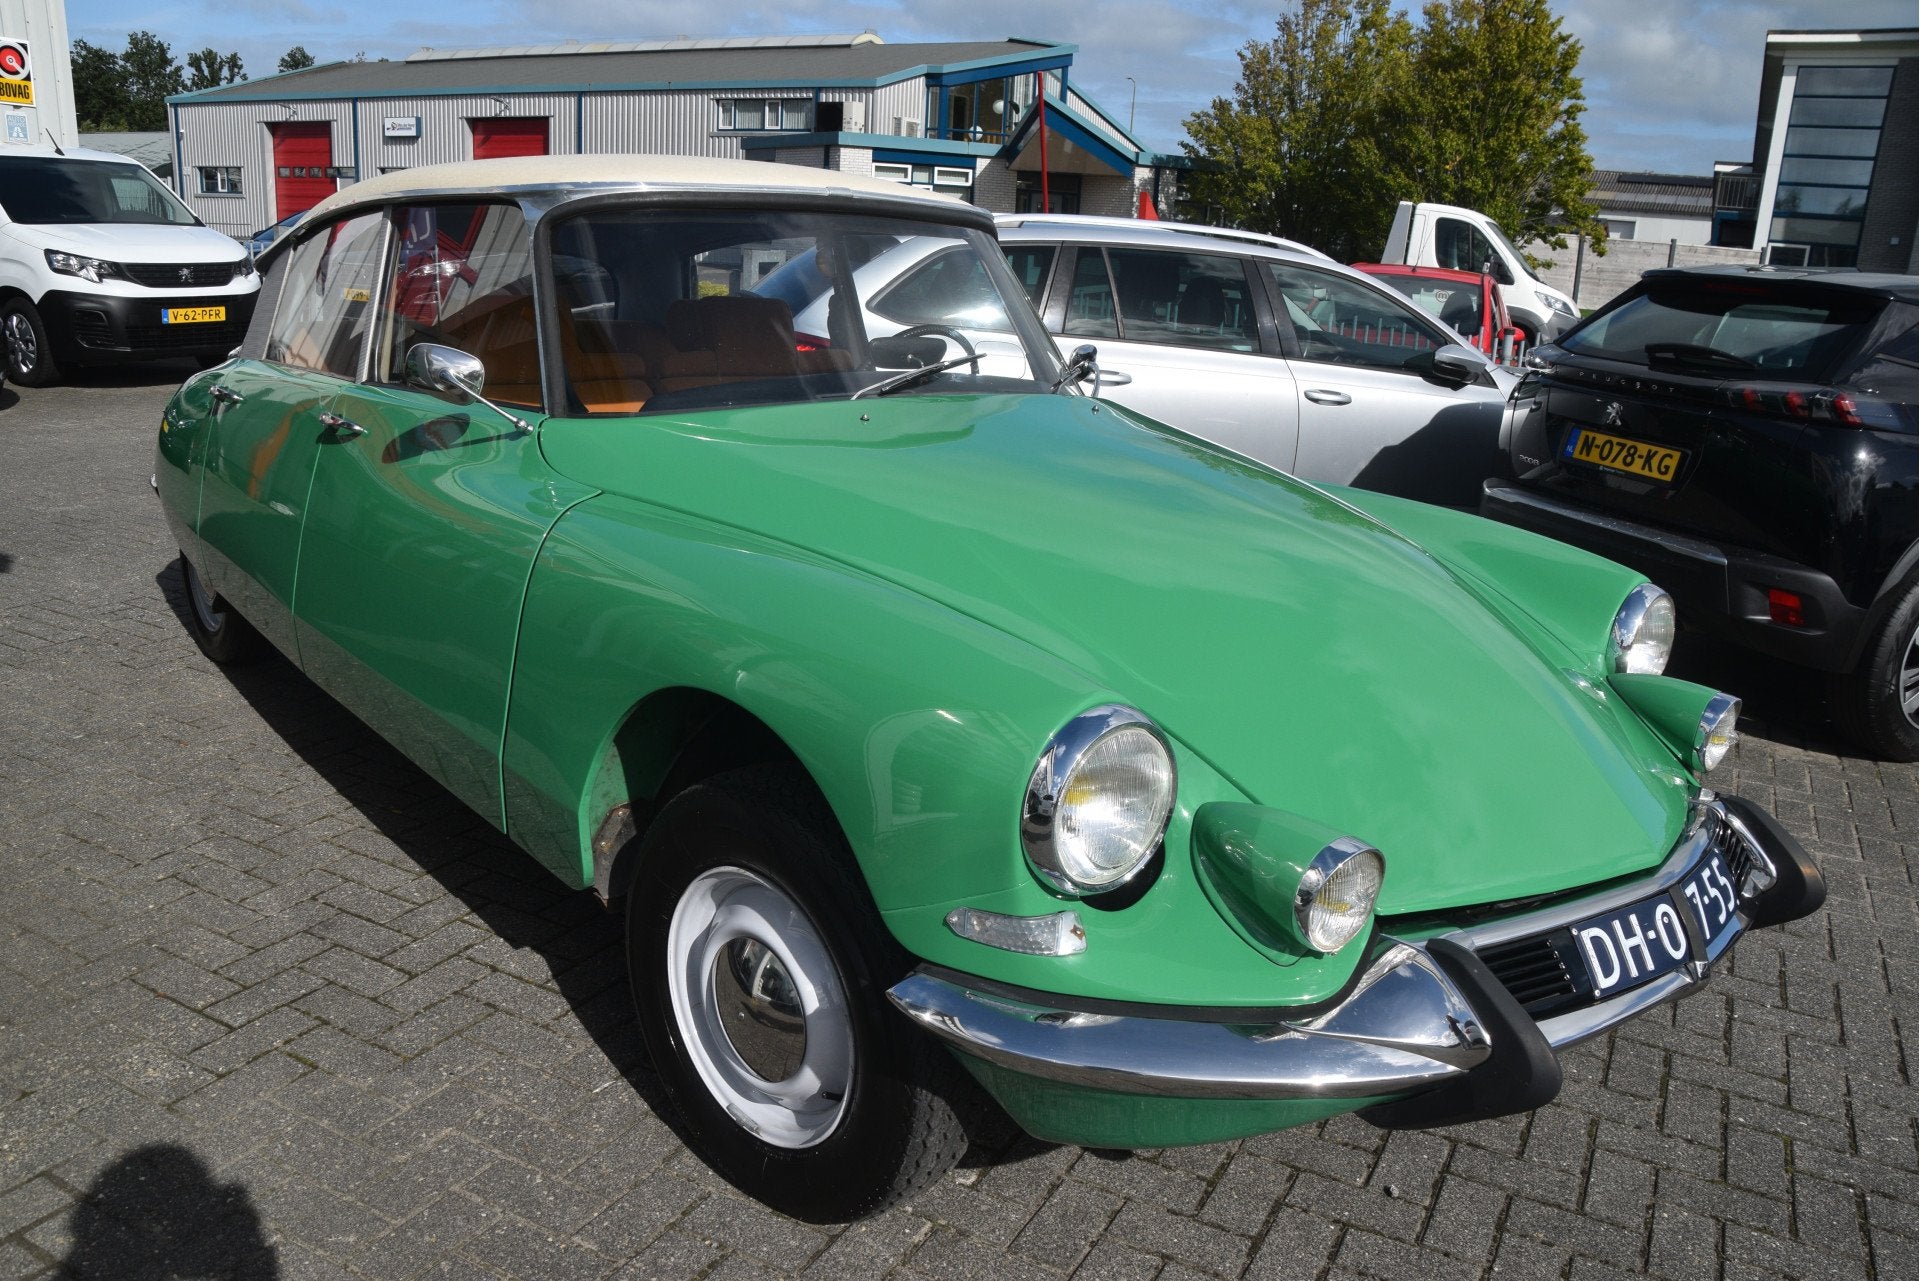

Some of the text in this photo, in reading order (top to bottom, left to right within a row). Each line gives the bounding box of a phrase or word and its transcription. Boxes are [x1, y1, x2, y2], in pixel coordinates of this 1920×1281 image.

[0, 82, 30, 99] BOVAG
[172, 309, 222, 321] V-62-PFR
[1578, 434, 1673, 476] N-078-KG
